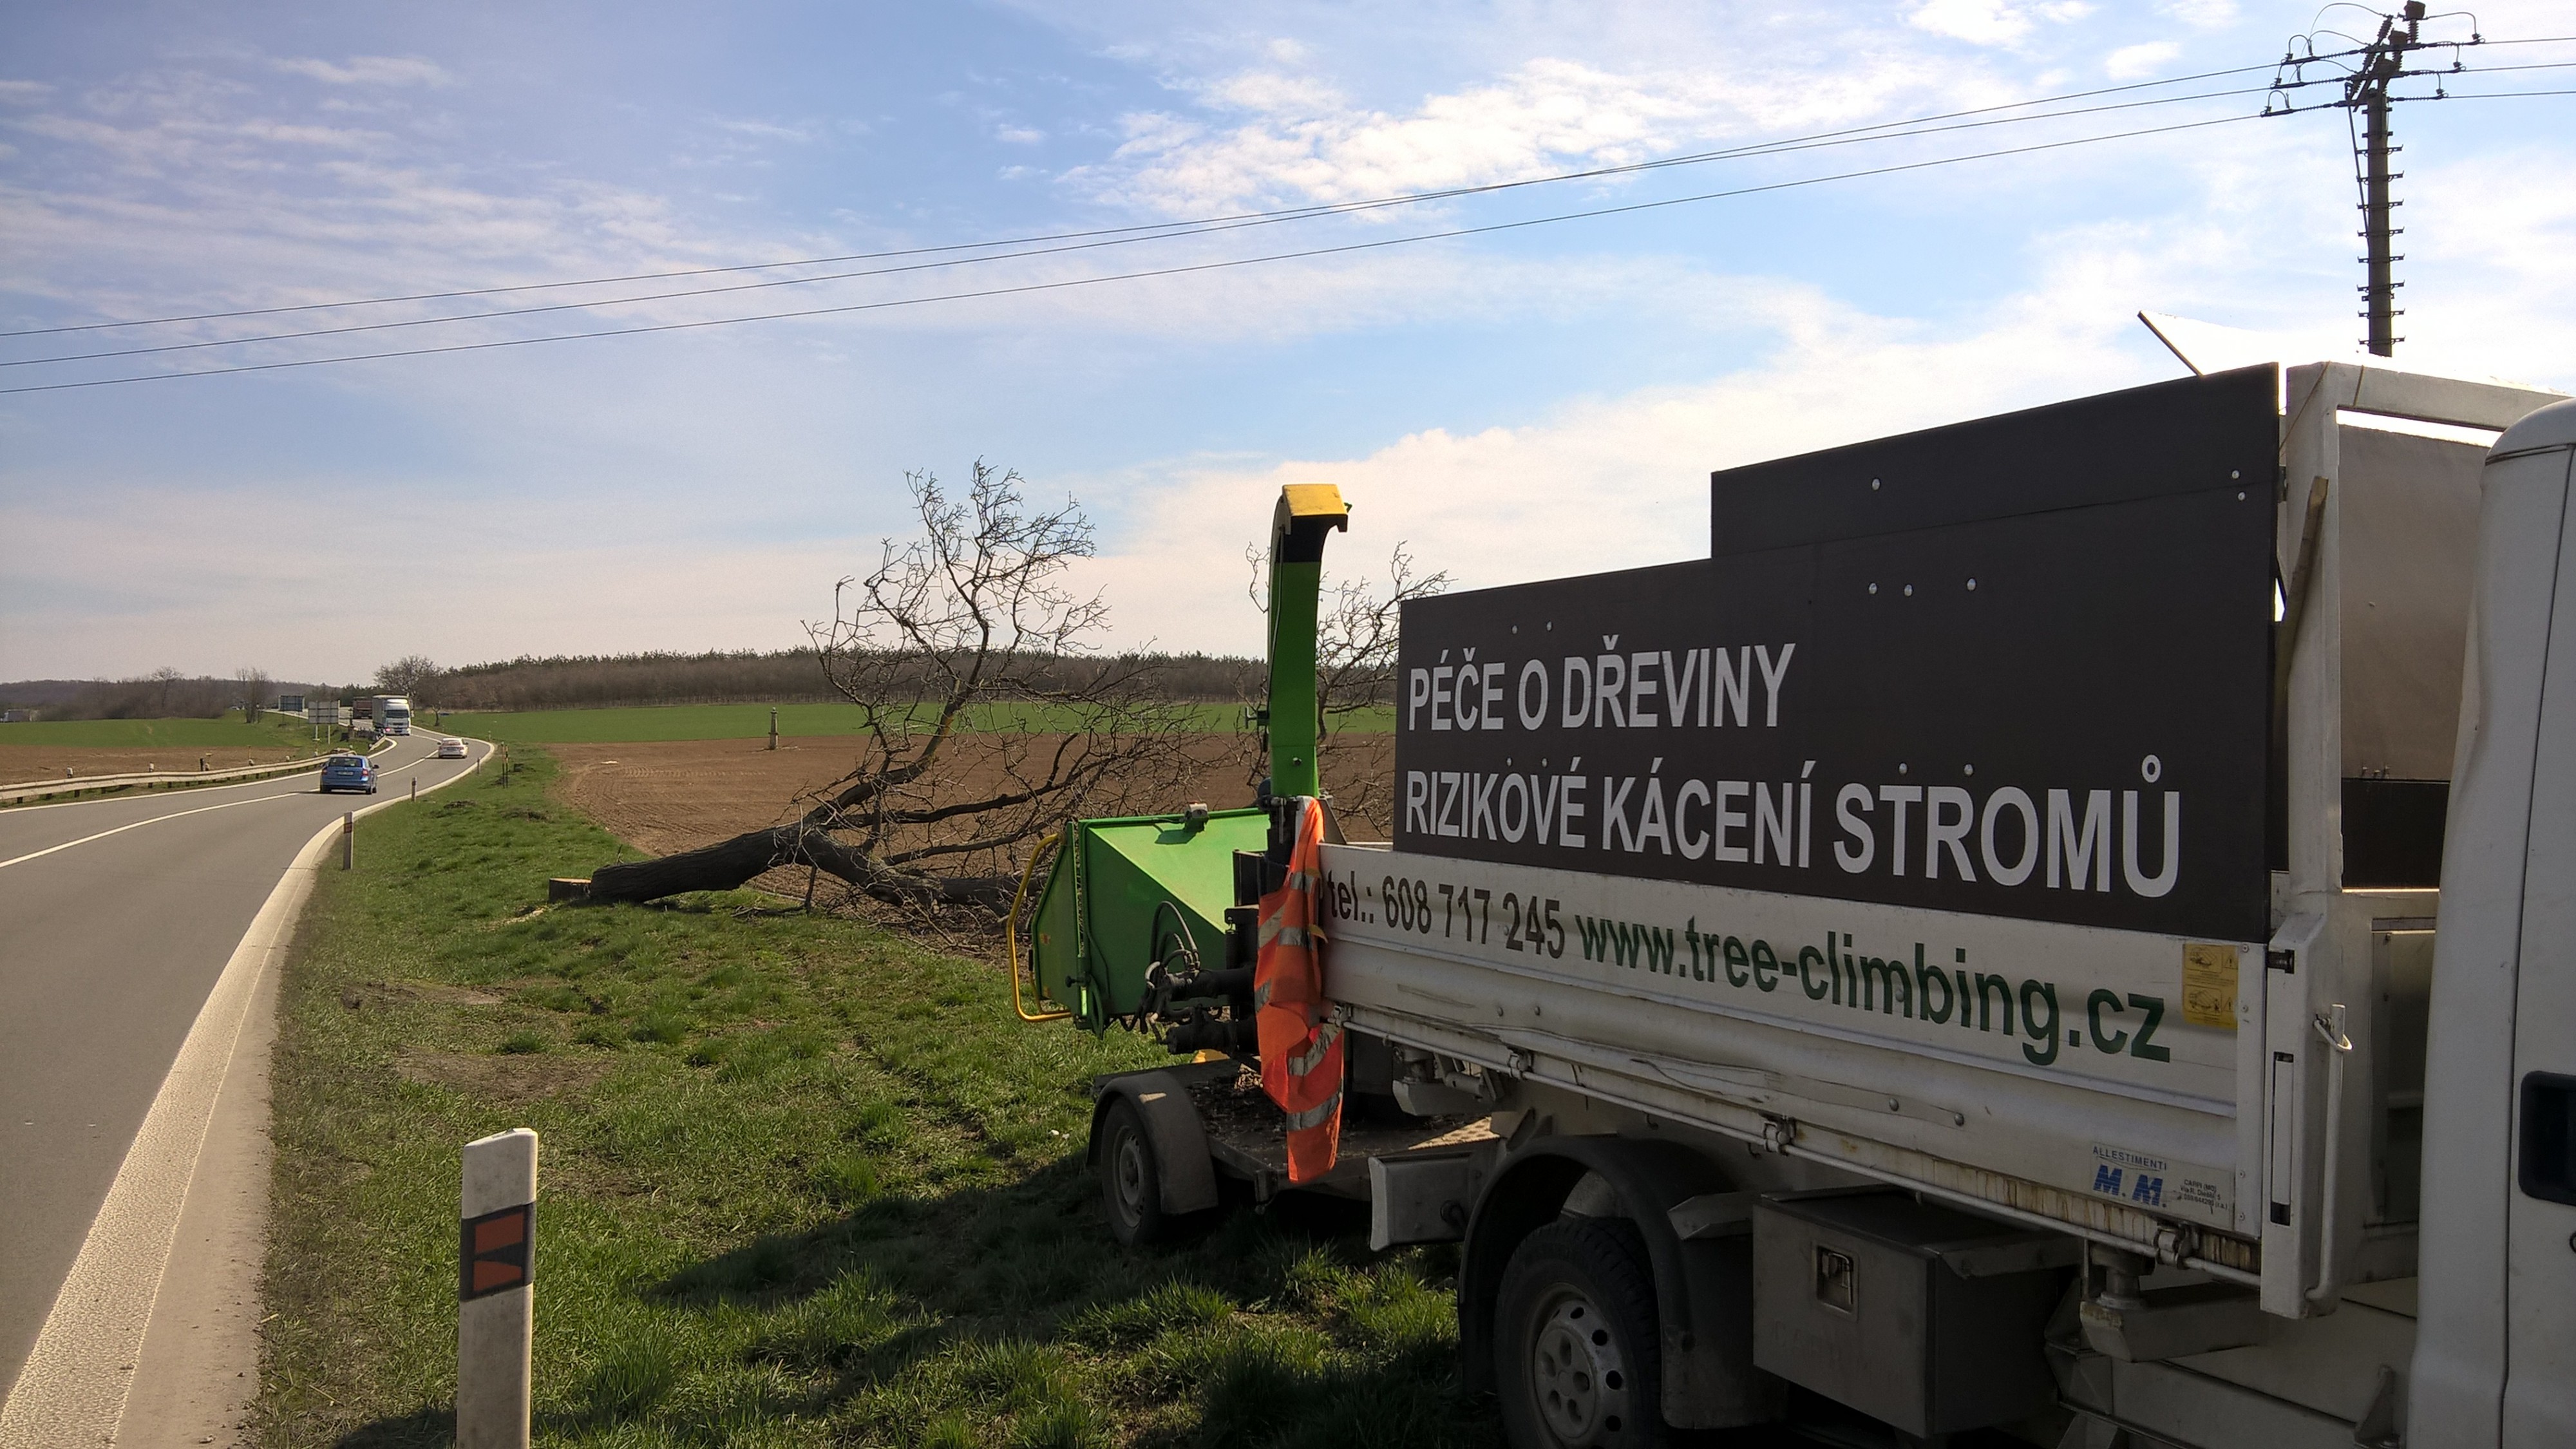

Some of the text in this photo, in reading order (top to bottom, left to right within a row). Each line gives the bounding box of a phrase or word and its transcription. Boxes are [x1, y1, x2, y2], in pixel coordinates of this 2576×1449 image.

[1408, 634, 1796, 732] PÉČE O DŘEVINY
[1405, 754, 2181, 898] RIZIKOVÉ KÁCENÍ STROMŮ
[1327, 869, 2171, 1066] tel.: 608 717 245 www.tree-climbing.cz
[2092, 1146, 2168, 1171] ALLESTIMENTI
